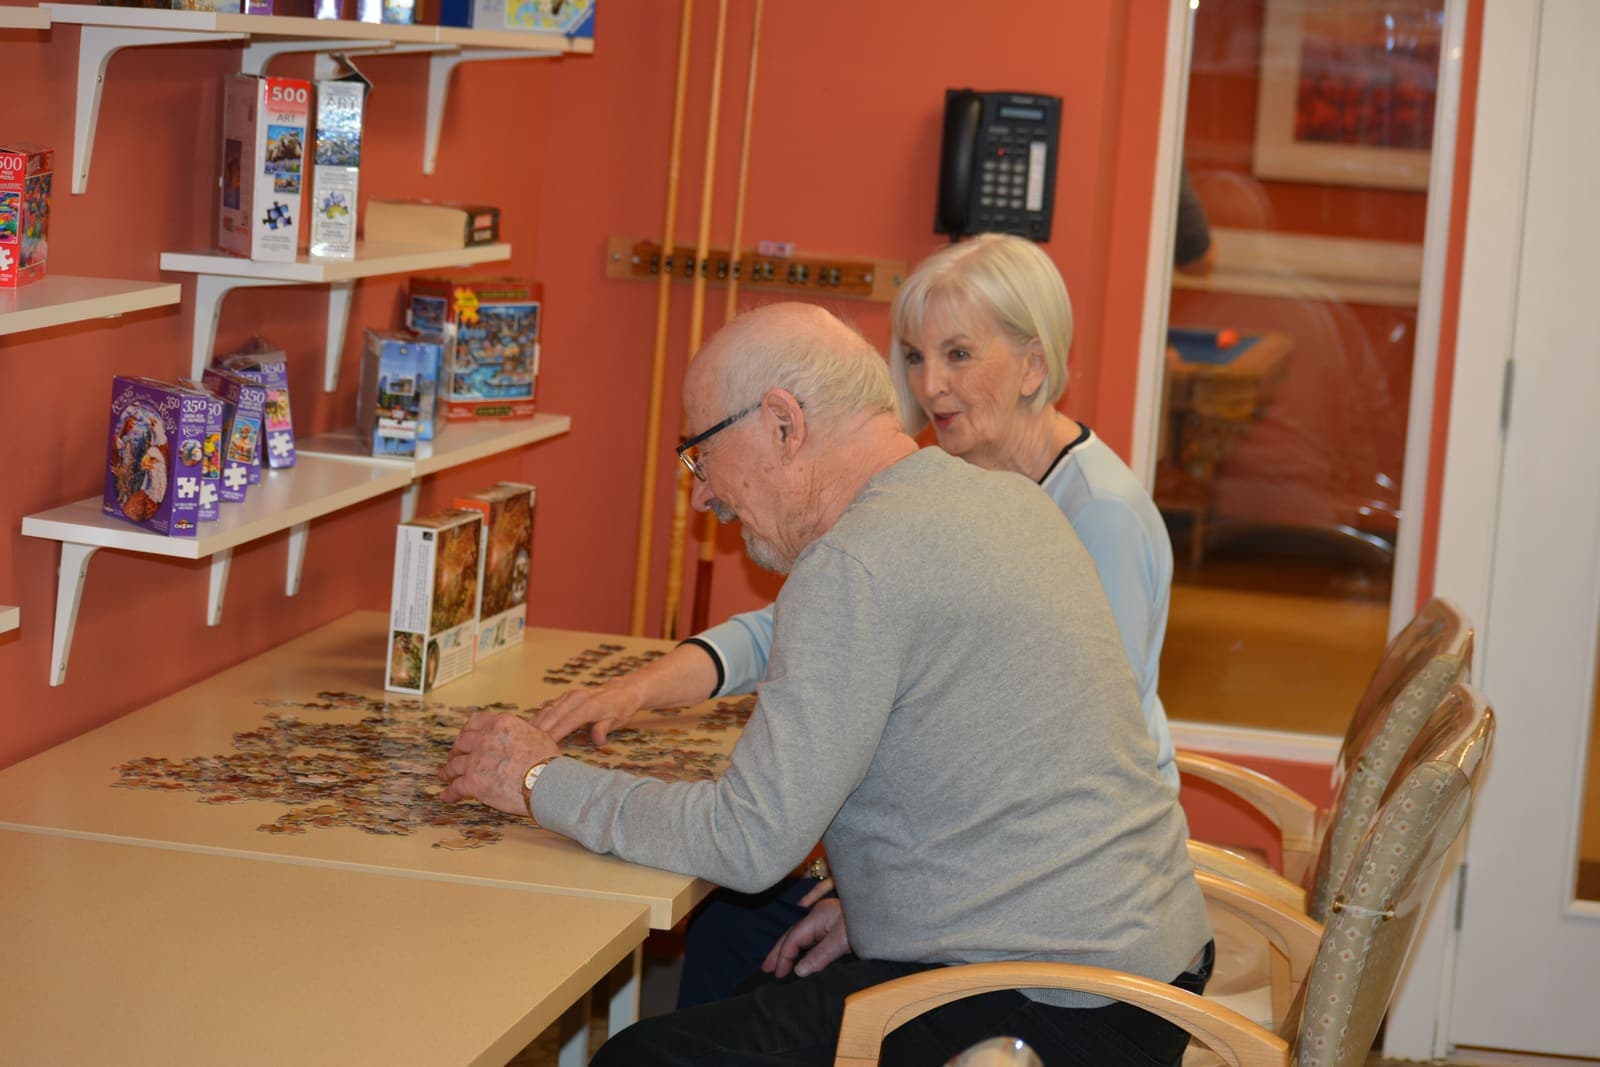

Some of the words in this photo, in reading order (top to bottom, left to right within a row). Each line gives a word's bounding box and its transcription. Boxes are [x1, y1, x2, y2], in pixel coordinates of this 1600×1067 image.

[271, 86, 307, 103] 500
[276, 114, 296, 122] ART
[240, 388, 265, 403] 350
[166, 396, 180, 410] 350
[183, 399, 207, 414] 350
[207, 403, 222, 417] 50
